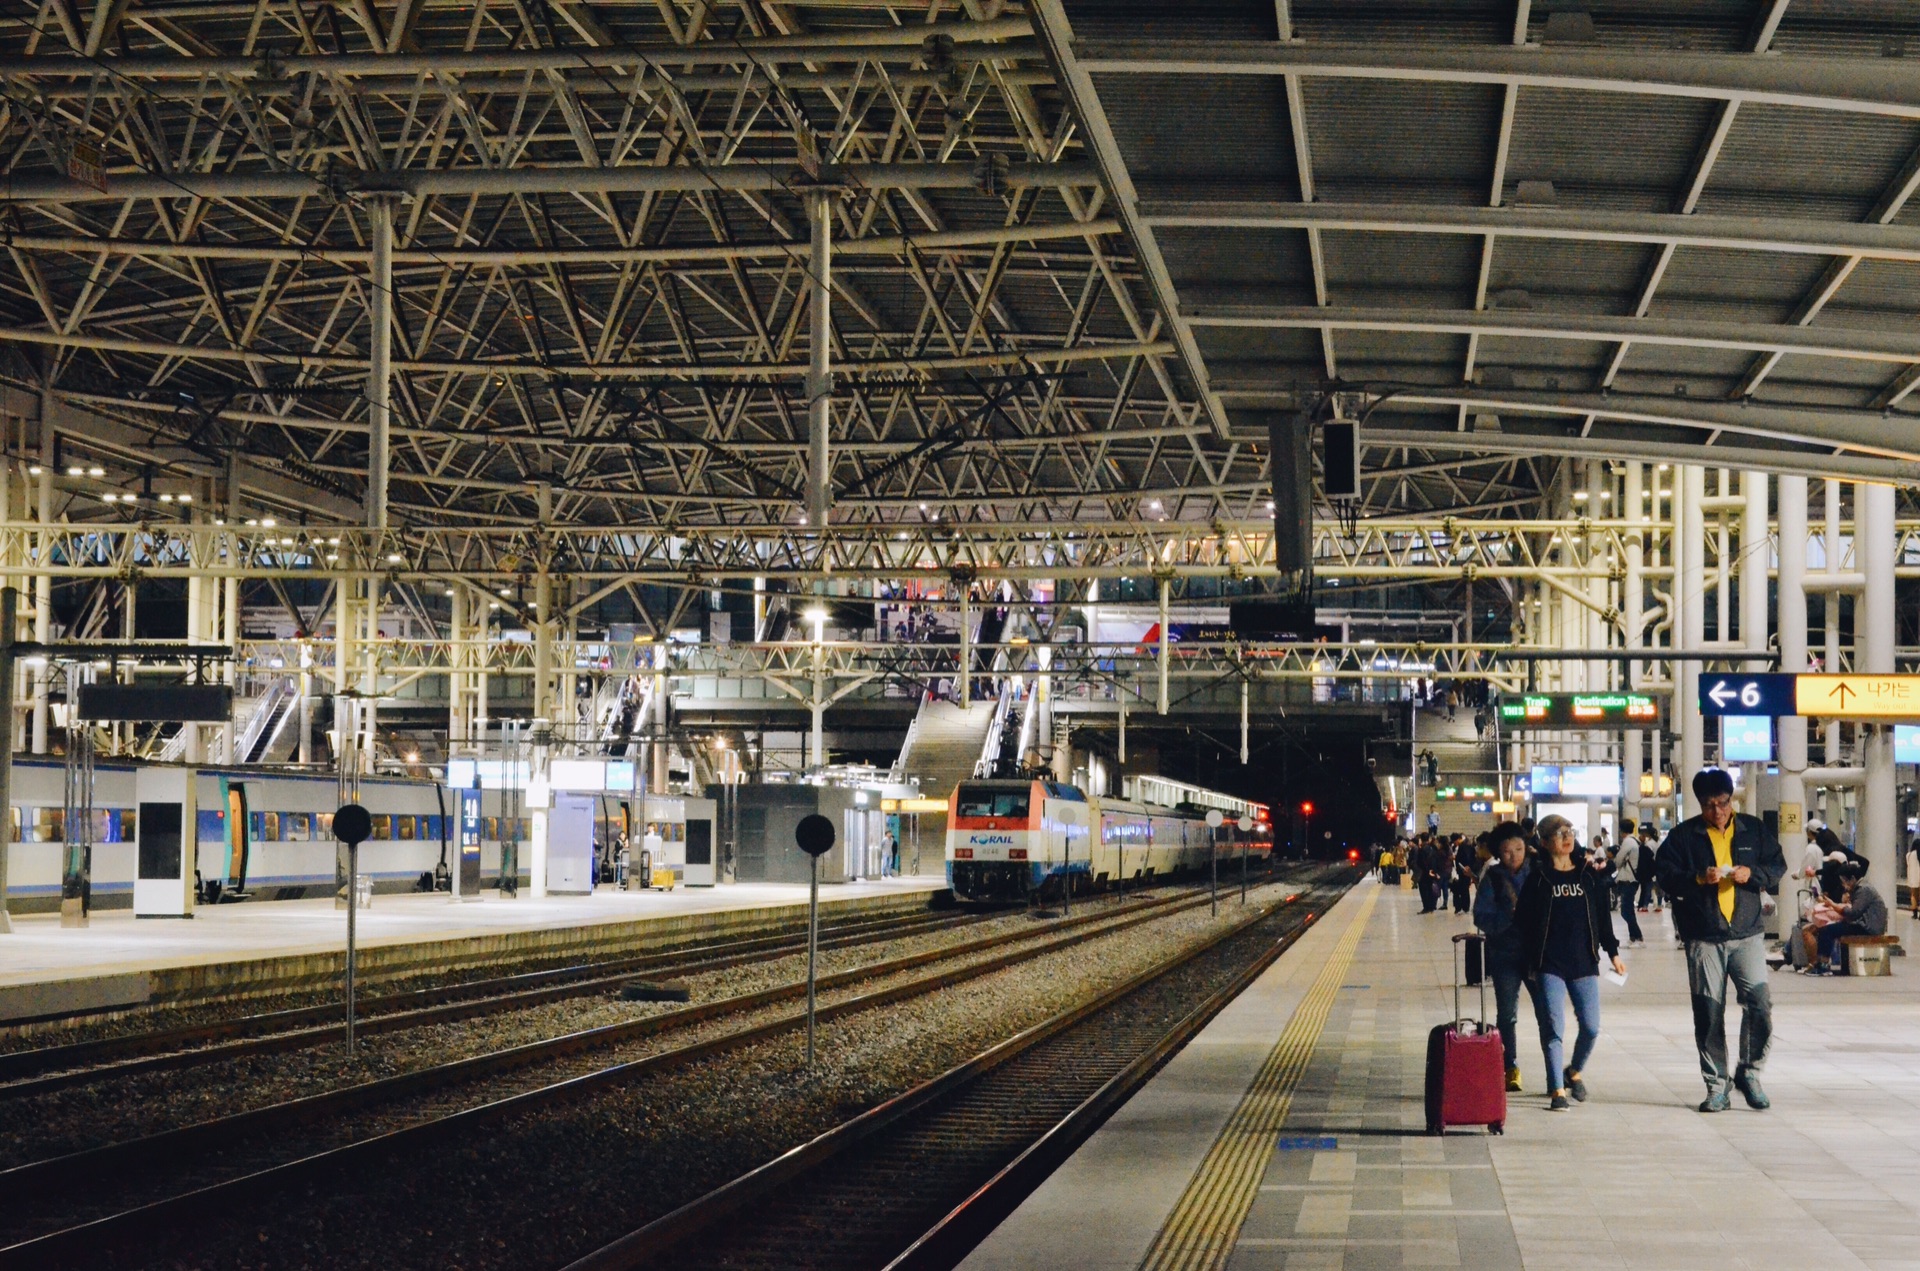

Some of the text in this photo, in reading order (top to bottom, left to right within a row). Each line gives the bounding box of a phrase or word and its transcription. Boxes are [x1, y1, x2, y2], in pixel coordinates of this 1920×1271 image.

[1741, 682, 1760, 707] 6
[1867, 682, 1910, 698] 나가는
[1525, 696, 1650, 707] Train Destination Time
[970, 833, 1013, 845] KORAIL
